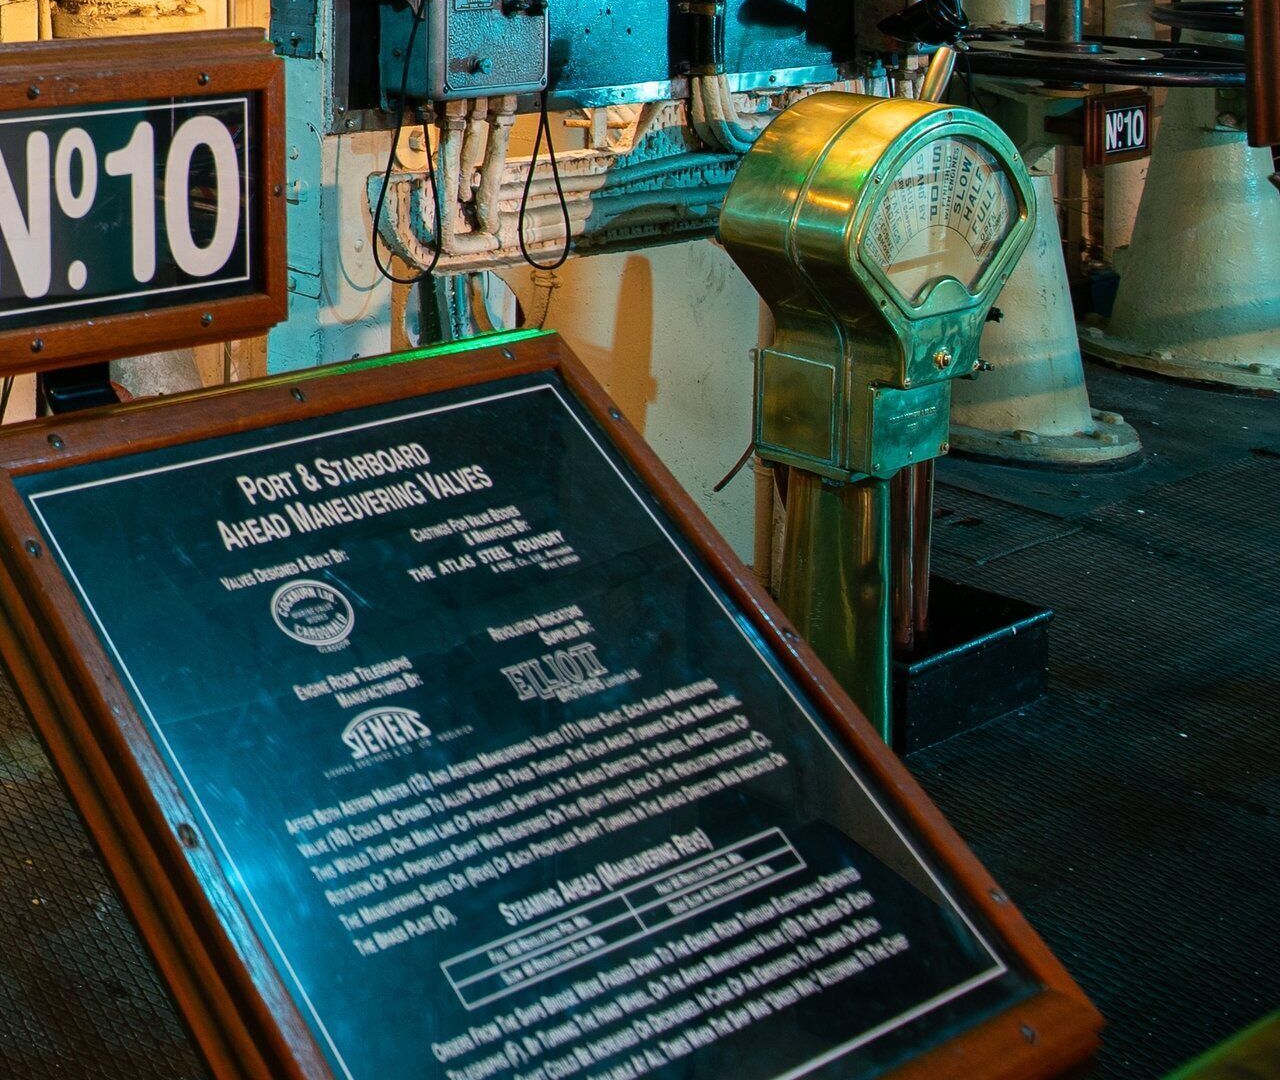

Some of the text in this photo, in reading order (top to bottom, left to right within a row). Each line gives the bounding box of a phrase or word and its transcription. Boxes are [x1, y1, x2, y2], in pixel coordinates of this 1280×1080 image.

[953, 155, 975, 215] SLOW
[963, 165, 985, 222] HALF
[971, 189, 997, 236] FULL
[237, 443, 430, 504] PORT & STARBOARD
[217, 465, 492, 551] AHEAD MANEUVERING VALVES
[410, 506, 520, 542] CASTINGS FOR VALVE BODIES
[470, 523, 517, 543] MANIFOLDS
[220, 573, 257, 590] VALVES
[253, 562, 299, 582] DESIGNED
[305, 554, 332, 569] BUILT
[408, 566, 436, 582] THE
[438, 554, 476, 575] ATLAS
[477, 546, 512, 563] STEEL
[513, 531, 564, 553] FOUNDRY
[278, 585, 325, 617] COCKBURN
[487, 605, 583, 641] REVOLUTION INDICATORS
[539, 625, 580, 645] SUPPLIED
[293, 656, 412, 701] ENGINE ROOM TELEGRAPHS
[335, 678, 407, 708] MANUFACTURED
[342, 708, 431, 759] SIEMENS
[499, 828, 713, 926] STEAMING AHEAD (MANEUVERING REVS)
